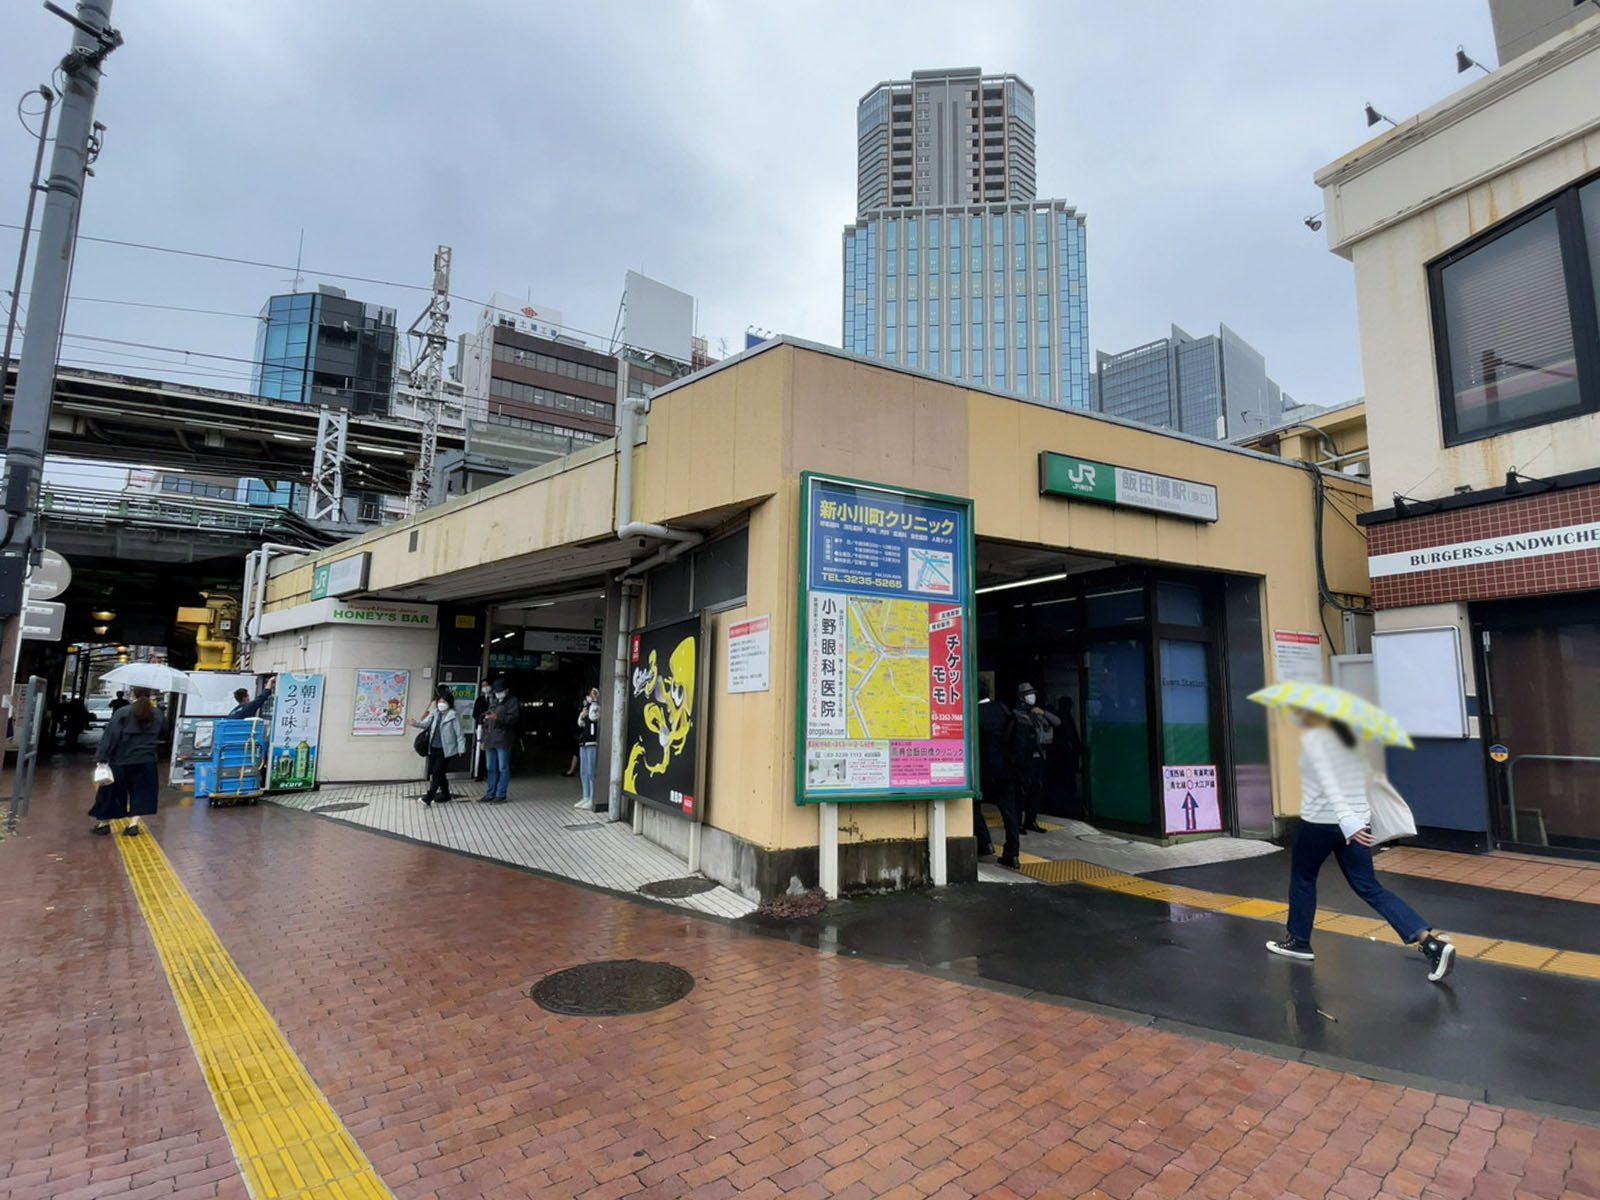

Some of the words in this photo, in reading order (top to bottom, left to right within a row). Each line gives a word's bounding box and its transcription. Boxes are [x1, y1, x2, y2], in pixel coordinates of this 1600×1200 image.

[1068, 463, 1096, 487] JR
[819, 500, 955, 535] 新小川町クリニック
[315, 570, 328, 590] JR
[821, 571, 903, 589] TEL.3235-5265
[333, 609, 397, 621] HONEY'S
[401, 614, 429, 623] BAR
[820, 598, 837, 719] 小野眼科医院
[946, 635, 959, 704] チケット
[301, 685, 316, 713] 朝には
[933, 666, 946, 704] モモ
